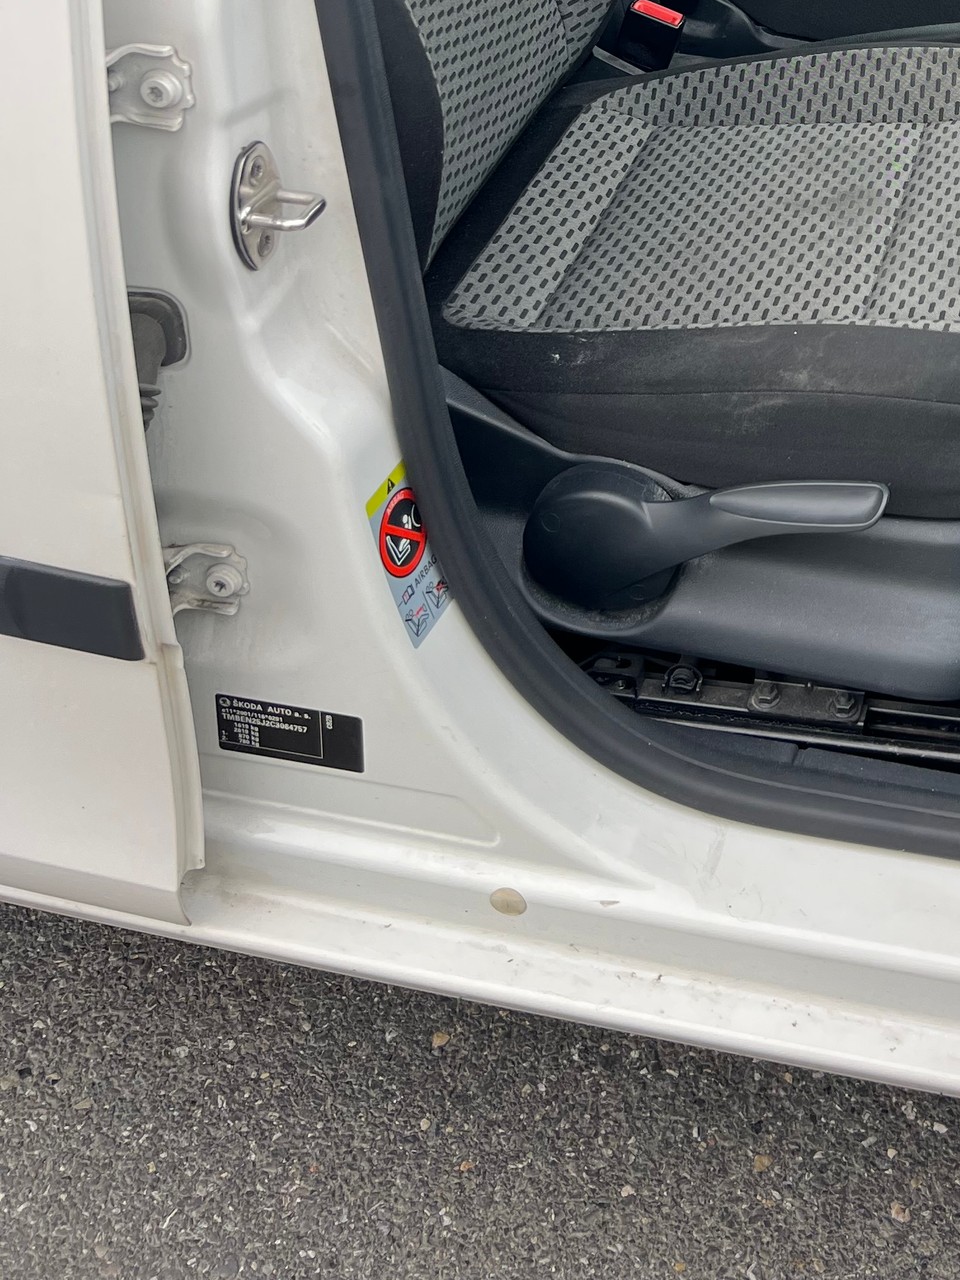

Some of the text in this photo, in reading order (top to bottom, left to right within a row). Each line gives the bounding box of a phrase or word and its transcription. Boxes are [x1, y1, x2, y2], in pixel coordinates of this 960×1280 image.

[414, 553, 438, 588] AIRBAG
[232, 698, 263, 711] ŠKODA
[267, 706, 292, 716] AUTO
